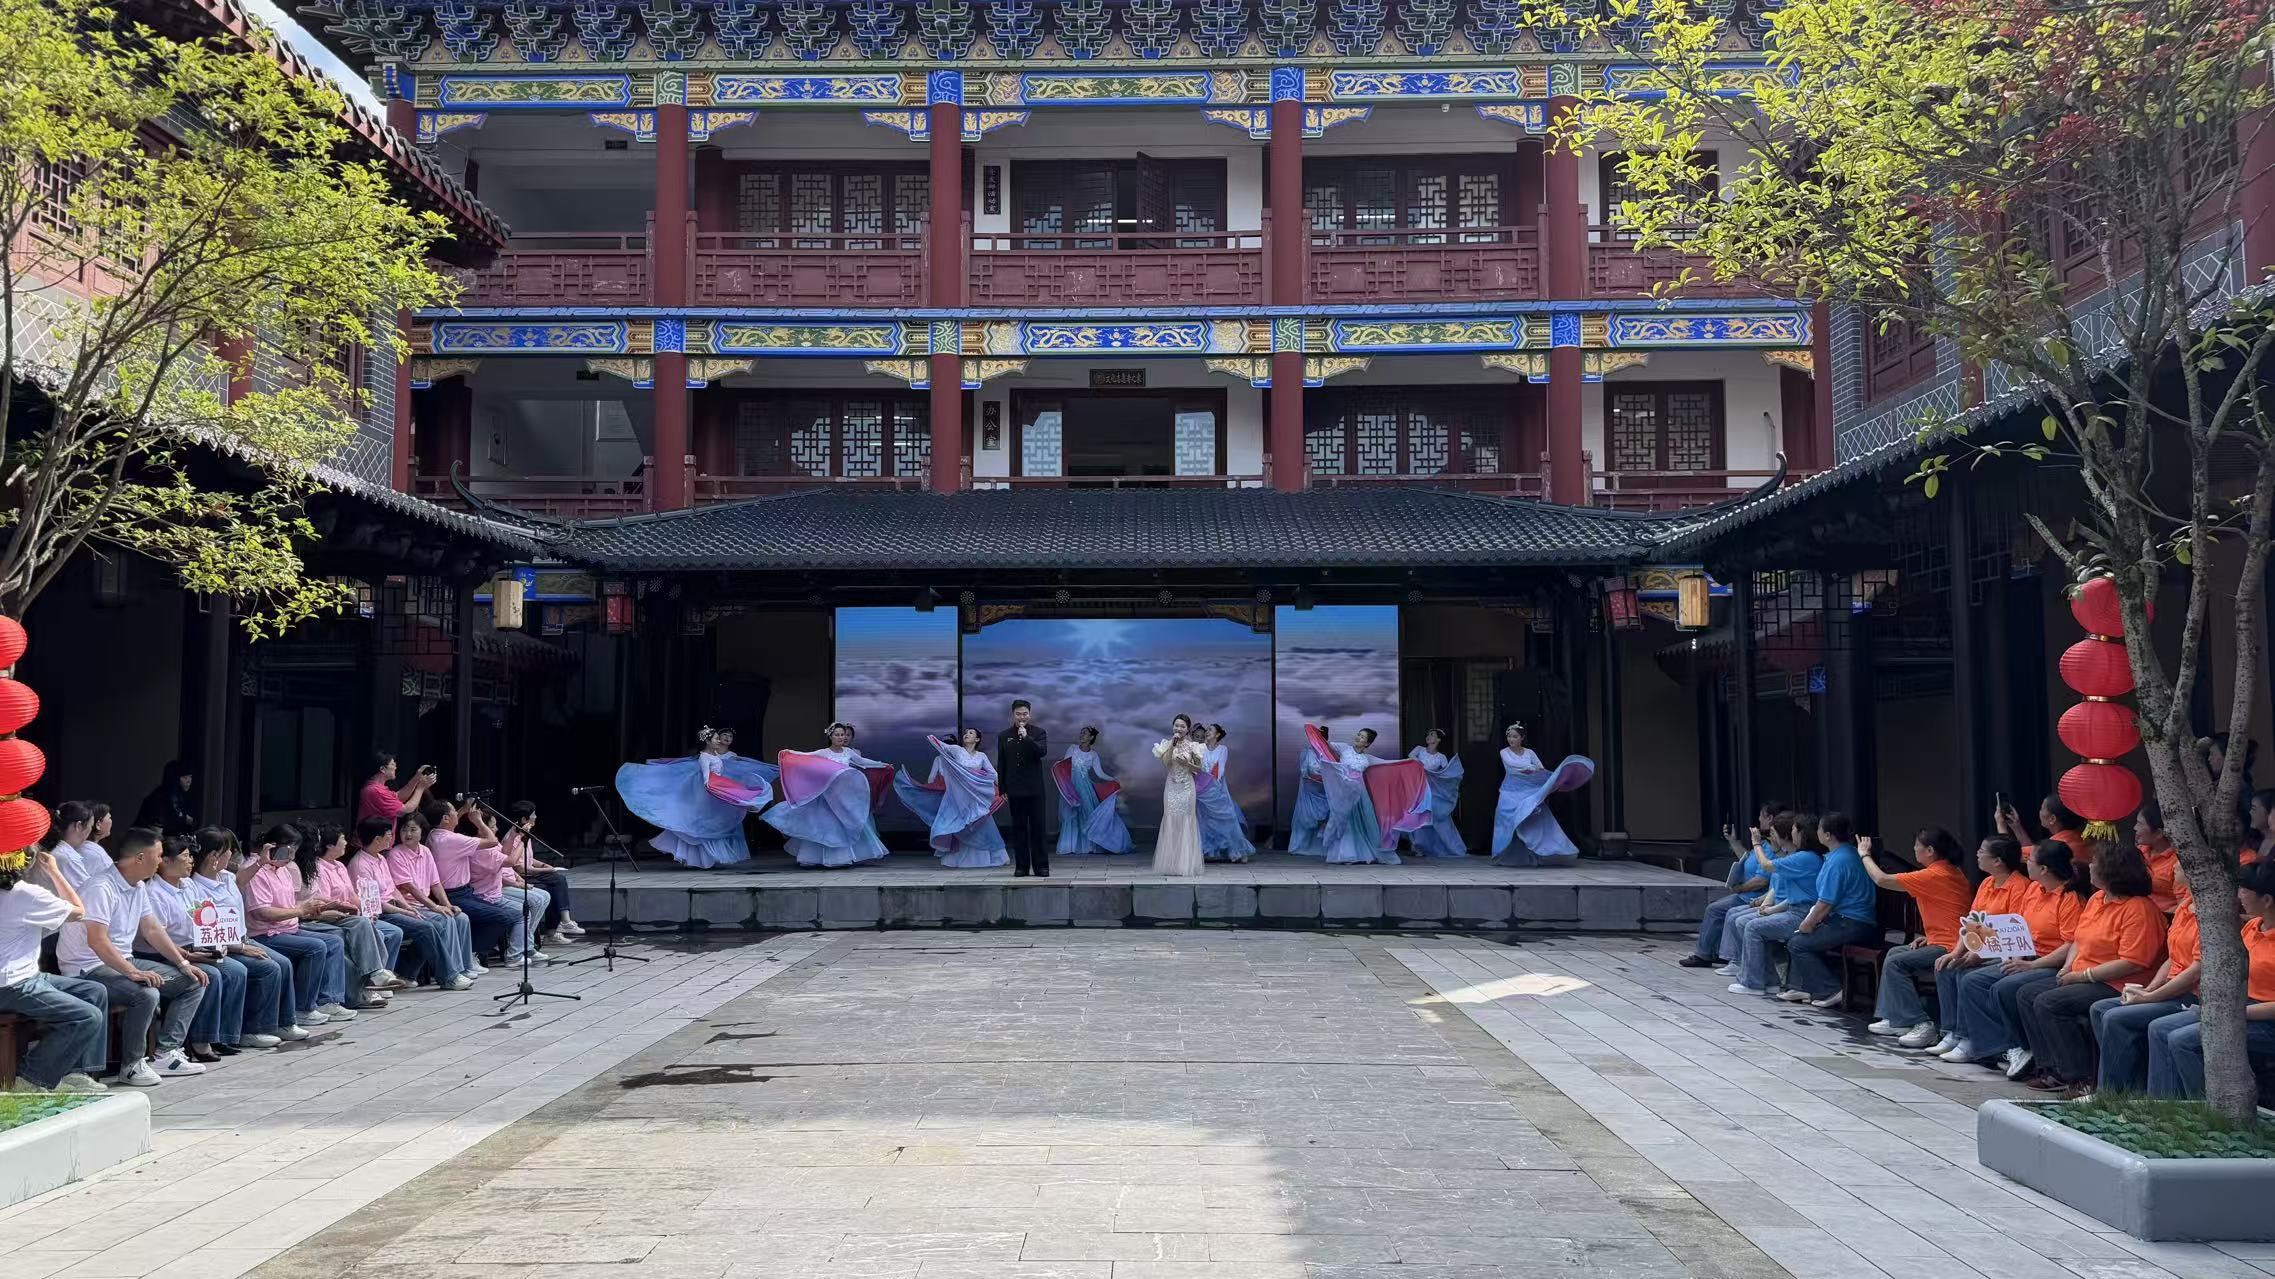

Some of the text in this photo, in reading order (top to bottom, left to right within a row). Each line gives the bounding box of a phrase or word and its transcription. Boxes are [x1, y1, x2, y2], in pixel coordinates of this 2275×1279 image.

[985, 405, 997, 447] 办公室
[200, 926, 240, 944] 荔枝队
[1986, 936, 2033, 953] 橘子队
